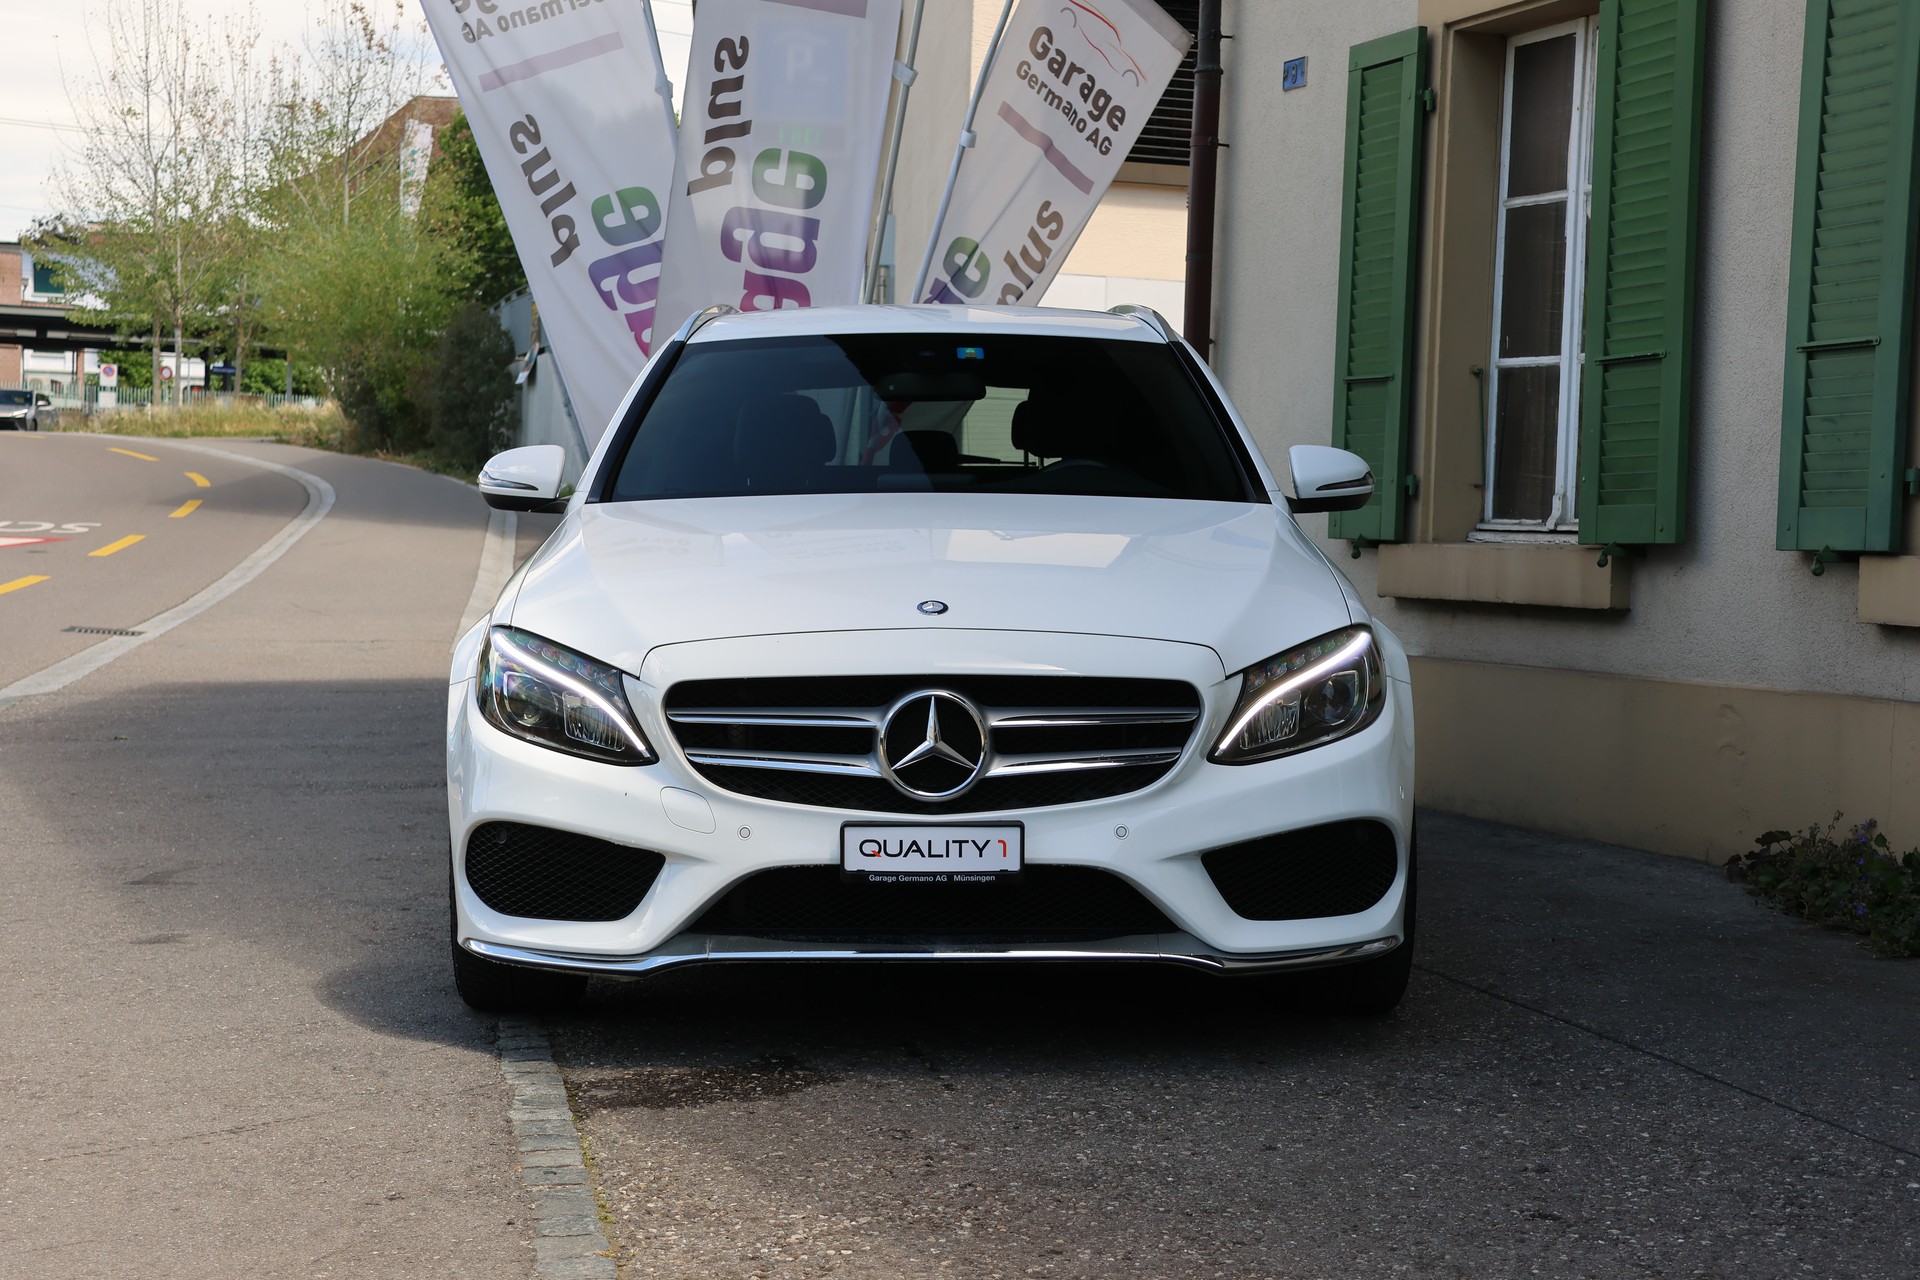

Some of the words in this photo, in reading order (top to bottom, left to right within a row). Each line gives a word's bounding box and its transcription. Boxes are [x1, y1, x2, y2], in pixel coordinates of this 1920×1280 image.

[1029, 26, 1126, 131] Garage
[1016, 60, 1087, 133] Germano
[1085, 127, 1112, 156] AG
[859, 839, 990, 858] QUALITY
[869, 874, 897, 882] Garage
[899, 874, 933, 882] Germano
[936, 874, 947, 882] AG
[954, 874, 995, 882] Münsingen
